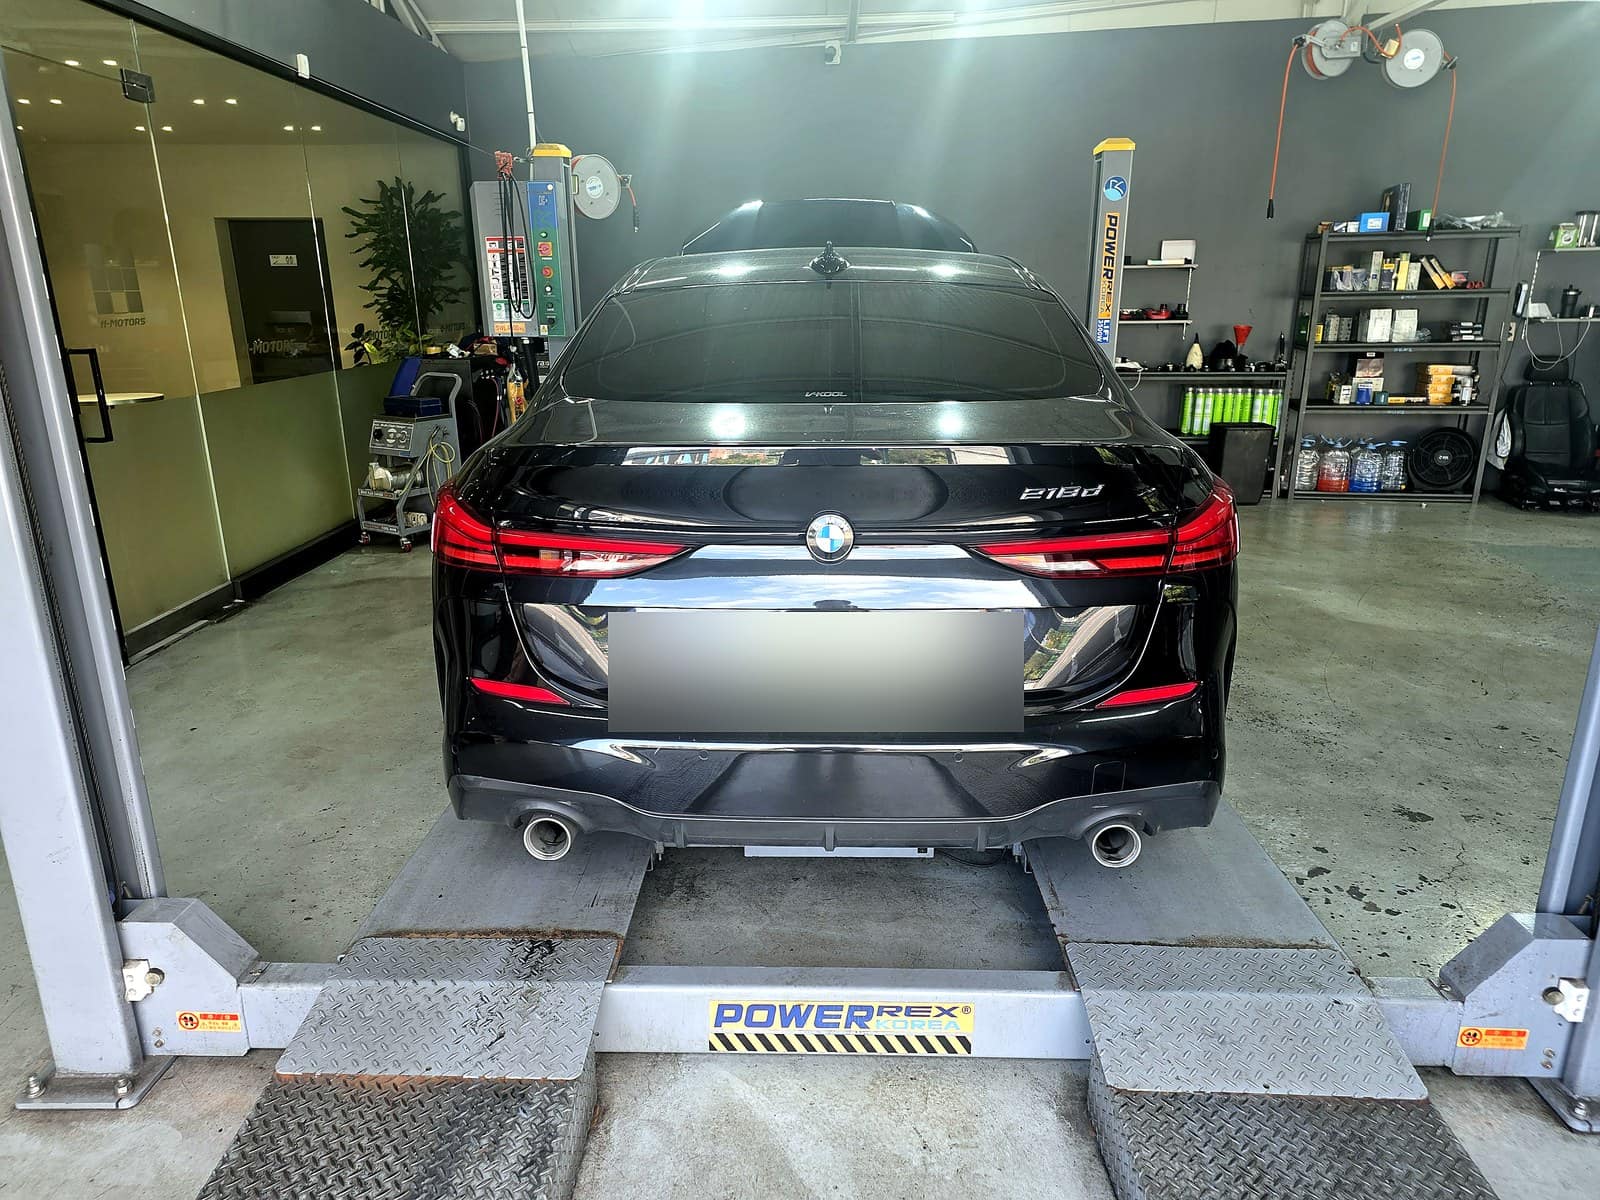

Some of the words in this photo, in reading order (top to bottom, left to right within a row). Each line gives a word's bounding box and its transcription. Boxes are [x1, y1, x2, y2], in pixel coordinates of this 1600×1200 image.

[1103, 319, 1111, 343] LIFT
[1020, 484, 1105, 500] 218d
[875, 1019, 961, 1030] KOREA
